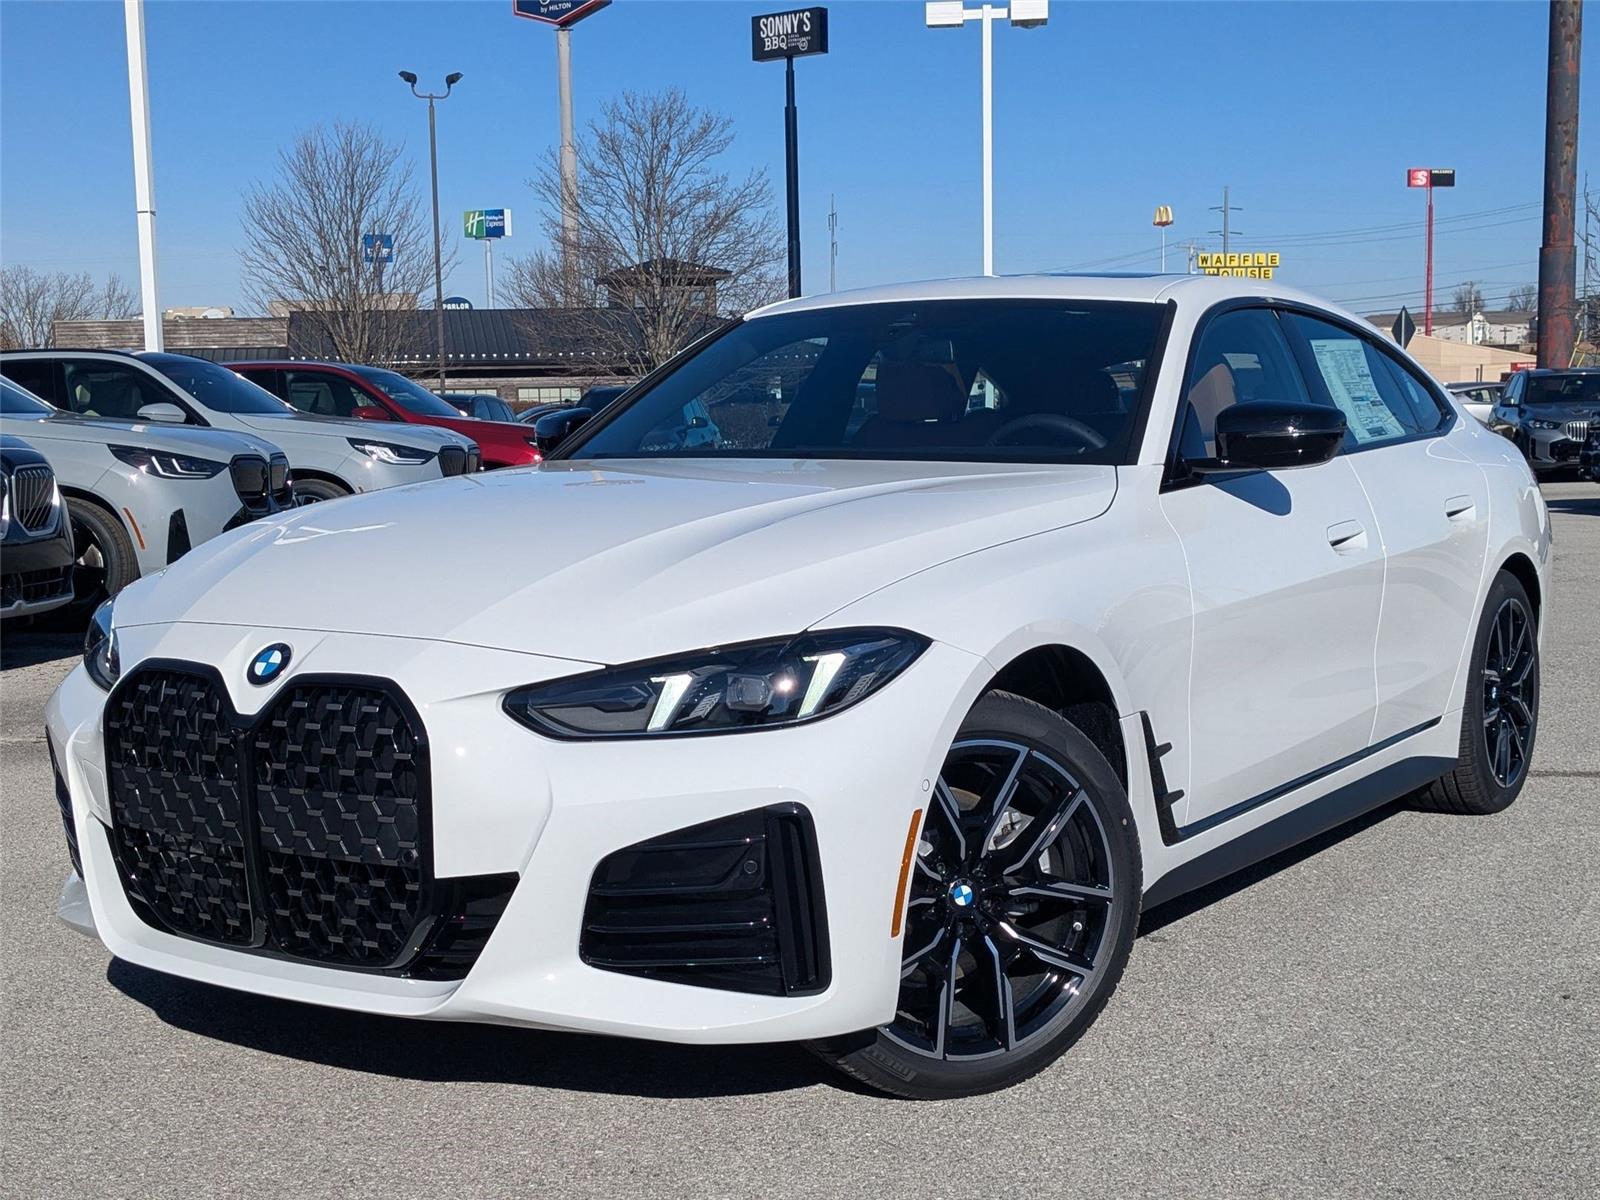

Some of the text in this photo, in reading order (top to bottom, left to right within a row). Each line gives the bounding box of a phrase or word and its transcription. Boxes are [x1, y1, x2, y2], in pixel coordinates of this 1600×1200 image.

[549, 2, 572, 11] HILTON
[760, 11, 811, 38] SONNY'S
[764, 35, 788, 51] BBQ
[1200, 255, 1278, 265] WAFFLE
